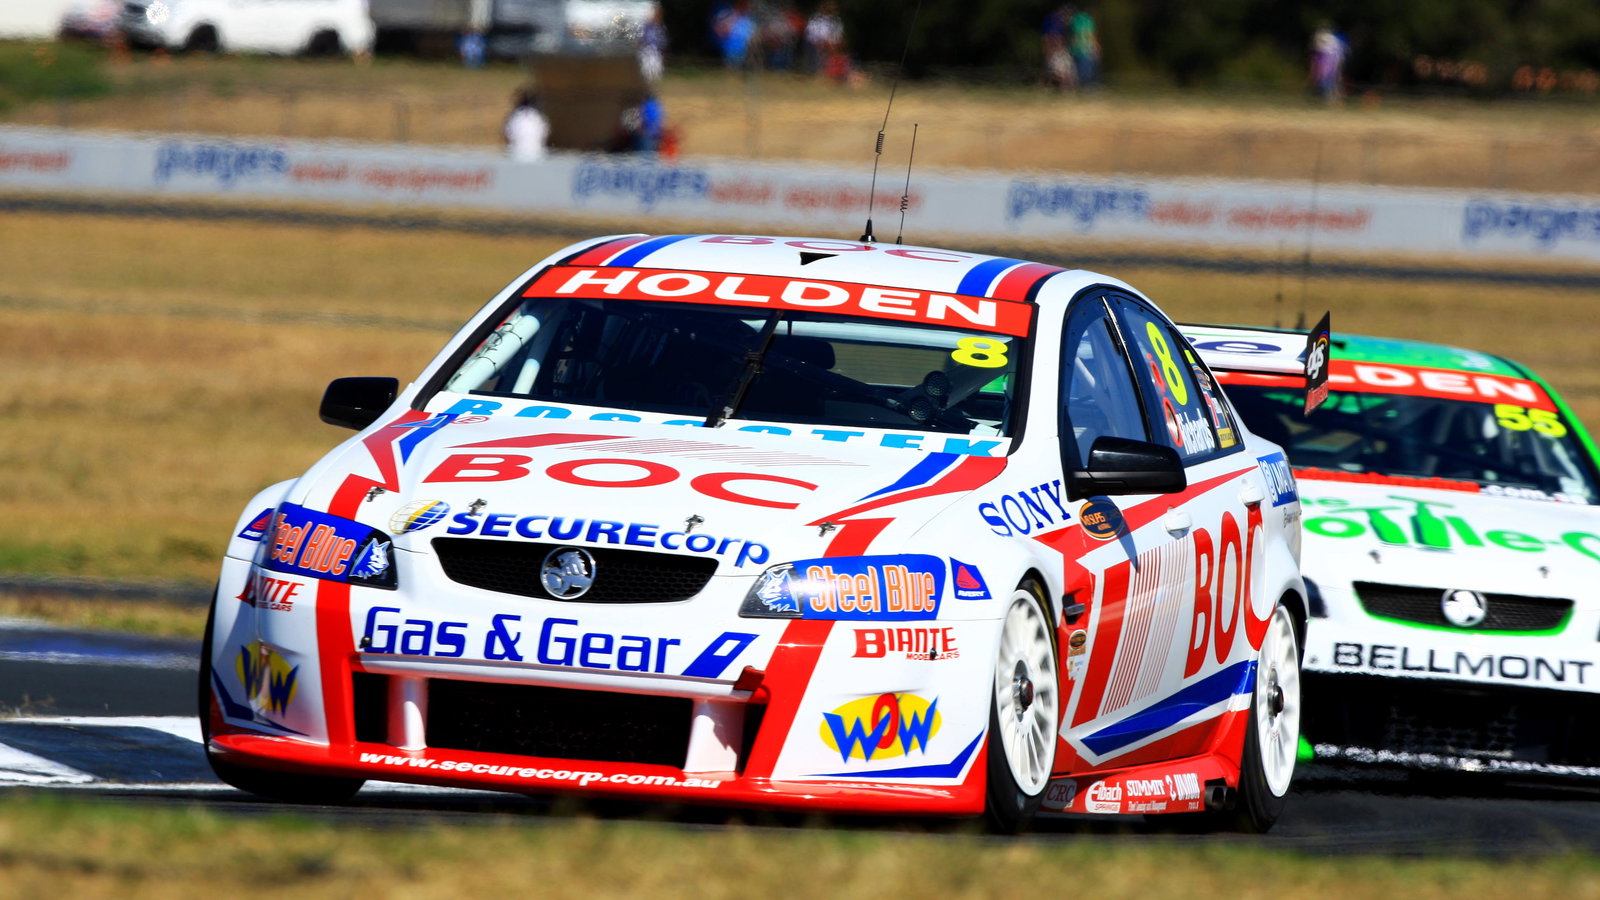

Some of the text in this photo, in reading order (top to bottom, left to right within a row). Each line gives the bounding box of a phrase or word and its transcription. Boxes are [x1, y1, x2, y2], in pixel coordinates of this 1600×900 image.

[699, 235, 974, 263] BOC
[556, 269, 998, 327] HOLDEN
[952, 336, 1008, 369] 8
[1146, 322, 1187, 405] 8
[1494, 404, 1566, 437] 55
[423, 454, 819, 509] BOC
[978, 479, 1071, 537] SONY
[271, 512, 356, 576] teel Blue
[446, 510, 770, 567] SECUREcorp
[807, 564, 936, 612] Steel Blue
[1183, 500, 1277, 680] BOC
[363, 606, 680, 673] Gas & Gear
[850, 627, 959, 658] BIANTE
[1334, 642, 1594, 684] BELLMONT
[822, 692, 939, 763] WOW
[359, 751, 722, 788] www.securecorp.com.au
[1127, 779, 1165, 797] SUMMIT
